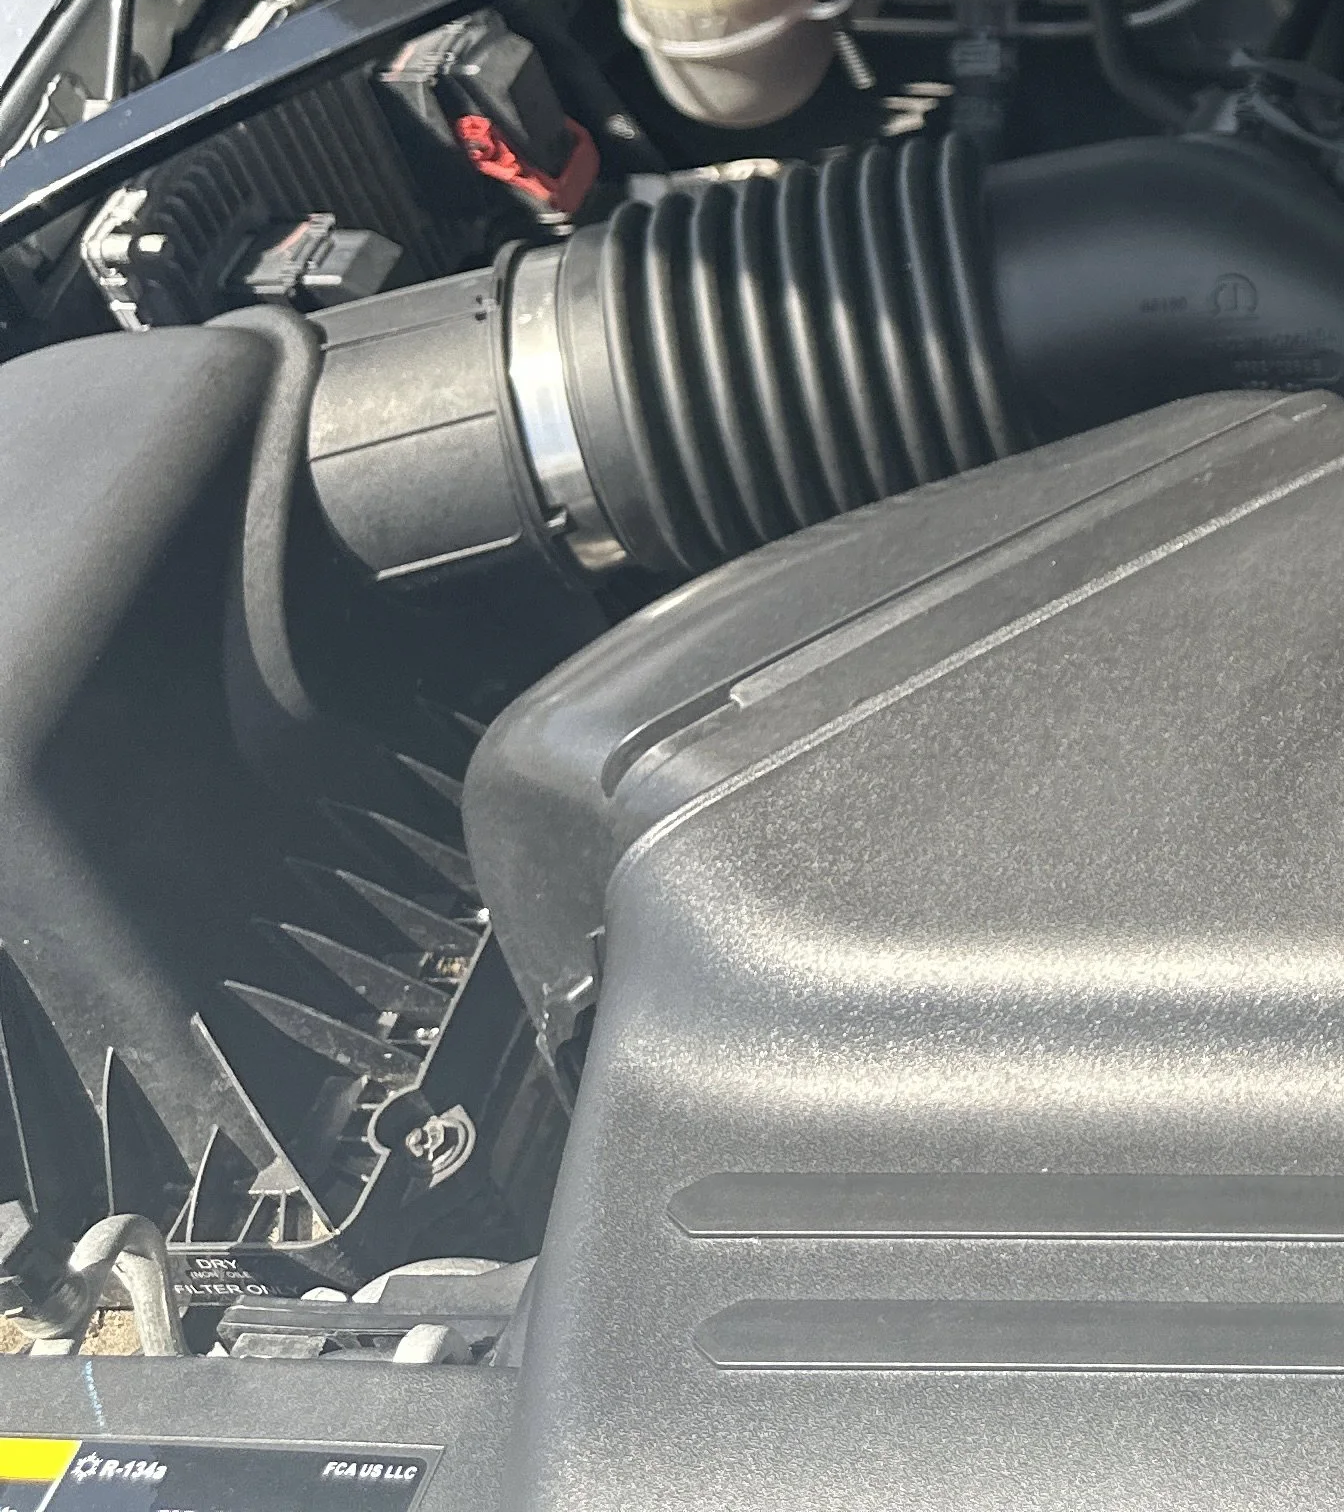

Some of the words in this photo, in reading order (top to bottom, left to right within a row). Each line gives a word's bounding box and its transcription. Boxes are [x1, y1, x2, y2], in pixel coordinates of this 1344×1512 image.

[195, 1258, 237, 1269] DRY
[174, 1284, 244, 1295] FILTER
[99, 1459, 168, 1481] R-134a
[322, 1461, 357, 1477] FCA
[359, 1463, 384, 1478] US
[384, 1465, 418, 1480] LLC
